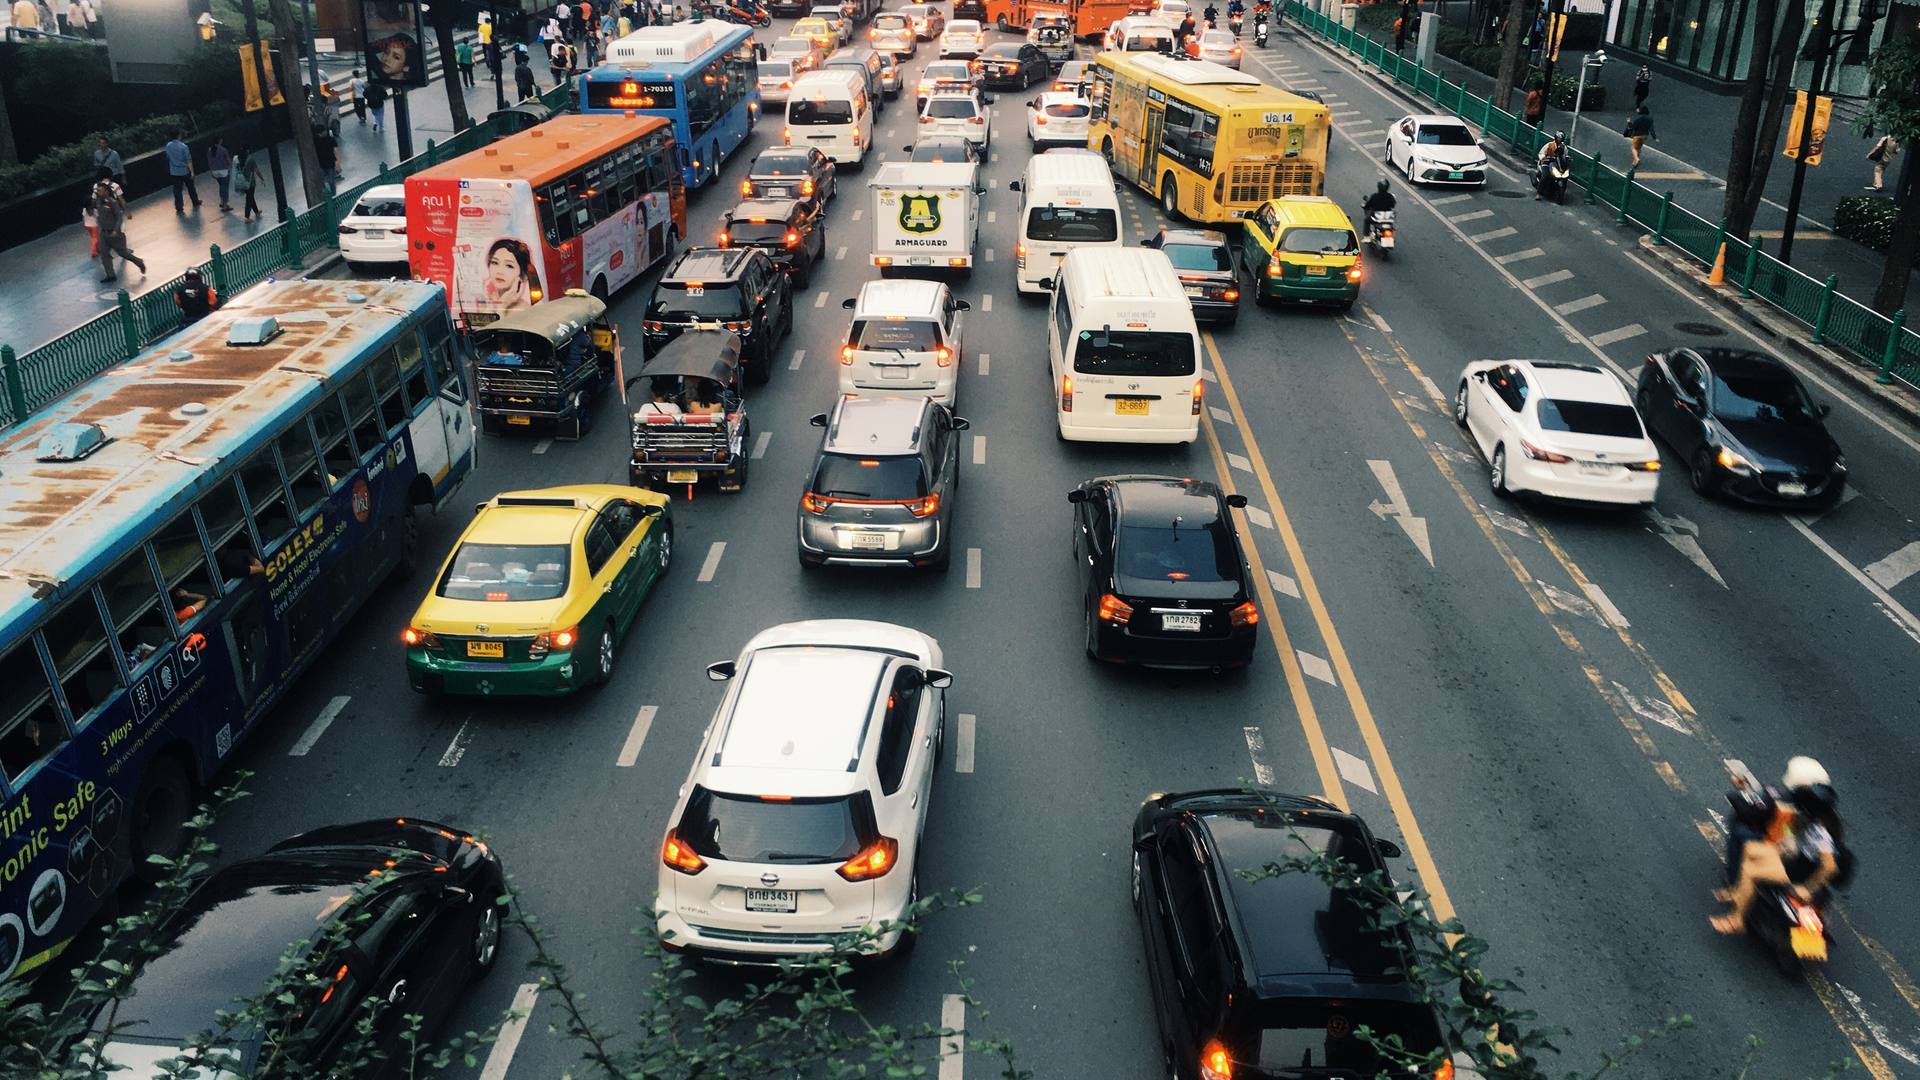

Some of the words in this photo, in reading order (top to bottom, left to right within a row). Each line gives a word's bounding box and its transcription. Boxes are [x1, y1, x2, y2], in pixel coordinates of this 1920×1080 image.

[625, 83, 637, 93] A3
[1282, 114, 1293, 122] 14
[265, 524, 314, 582] SOLEX
[269, 578, 289, 600] Home
[100, 740, 109, 756] 3
[108, 719, 133, 748] Ways
[0, 793, 32, 839] int
[53, 780, 96, 832] Safe
[770, 890, 793, 901] 3431
